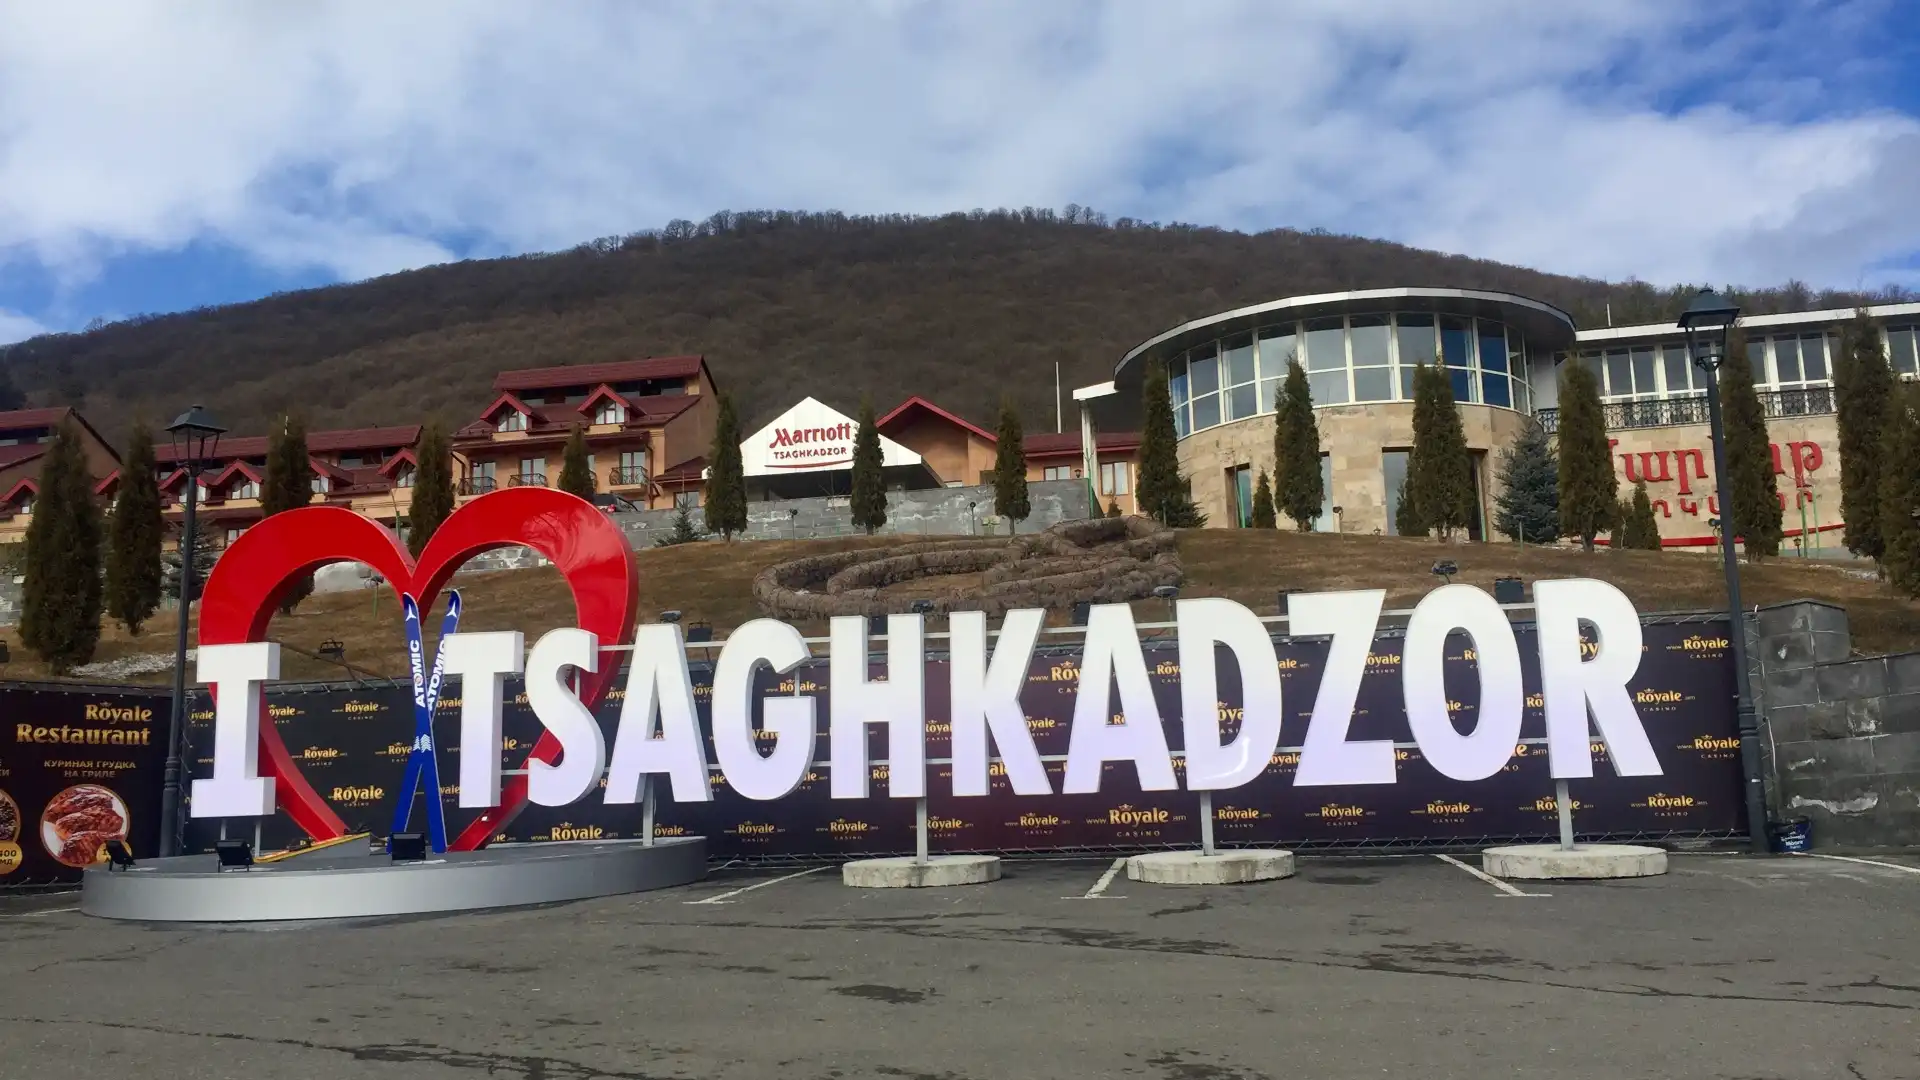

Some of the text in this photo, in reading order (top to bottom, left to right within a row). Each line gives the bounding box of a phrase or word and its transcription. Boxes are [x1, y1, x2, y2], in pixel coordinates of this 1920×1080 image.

[769, 423, 851, 448] Marriott
[774, 447, 847, 460] TSAGHKADZOR
[1683, 638, 1729, 651] Royale
[1279, 659, 1297, 668] ale
[1365, 654, 1400, 667] oyale
[410, 639, 426, 708] ATOMIC
[1051, 667, 1081, 684] Roy
[780, 681, 816, 692] Roale
[190, 577, 1664, 818] I TSAGHKADZOR
[436, 698, 462, 710] oyale
[1637, 690, 1682, 705] Royale
[85, 704, 152, 724] Royale
[268, 706, 296, 718] oyale
[344, 702, 379, 714] Royale
[1025, 717, 1055, 731] oyale
[16, 723, 150, 745] Restaurant
[1694, 737, 1740, 751] Royale
[304, 748, 338, 760] Royale
[44, 760, 136, 769] КУРИНАЯ ГРУДКА
[64, 770, 116, 778] НА ГРИЛЕ
[333, 785, 383, 804] Royale
[1427, 803, 1470, 816] Royale
[1648, 796, 1694, 810] Royale
[1109, 807, 1169, 827] Royale
[1219, 808, 1259, 821] Royale
[1322, 805, 1363, 819] Royale
[830, 820, 868, 833] Royale
[1020, 815, 1058, 828] Royale
[552, 824, 603, 841] Royale
[654, 825, 683, 837] oyale
[738, 823, 774, 835] Royale
